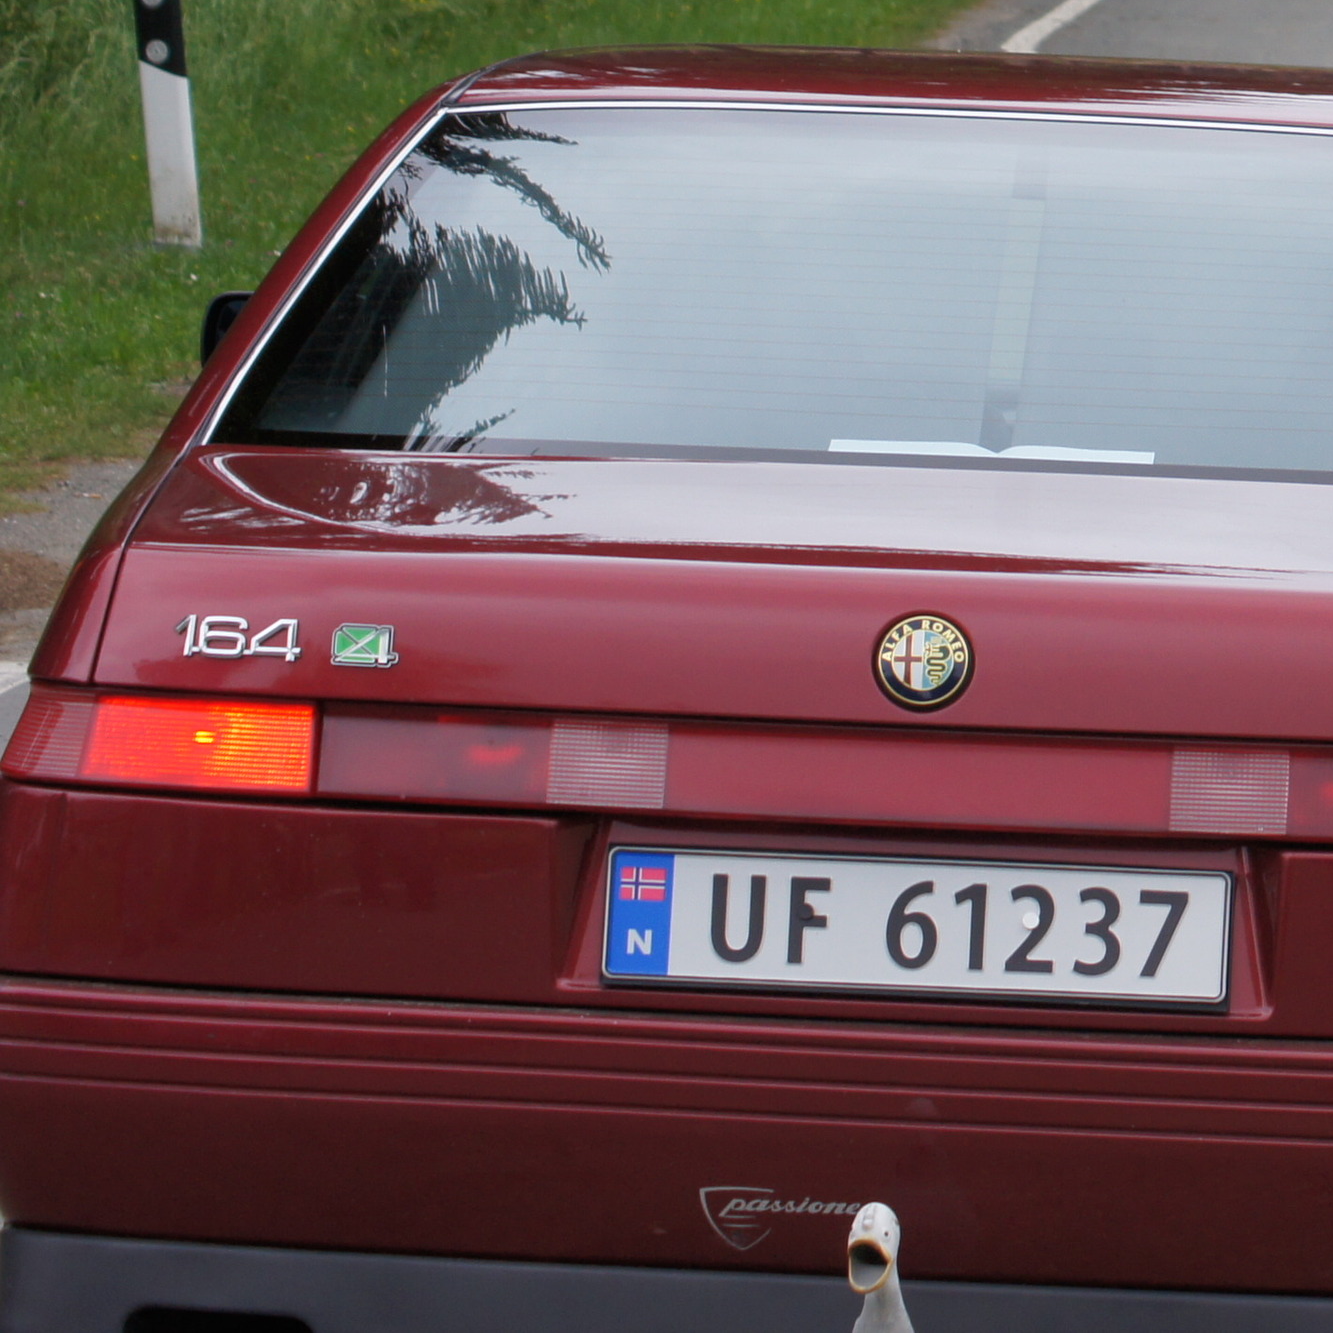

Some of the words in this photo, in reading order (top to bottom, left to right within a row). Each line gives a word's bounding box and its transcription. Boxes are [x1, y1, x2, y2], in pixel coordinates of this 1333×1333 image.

[174, 613, 301, 663] 164
[882, 624, 913, 661] ALFA
[921, 620, 964, 662] ROMEO
[626, 929, 651, 955] N
[710, 873, 831, 965] UF
[885, 879, 1189, 978] 61237
[718, 1197, 862, 1216] passione
